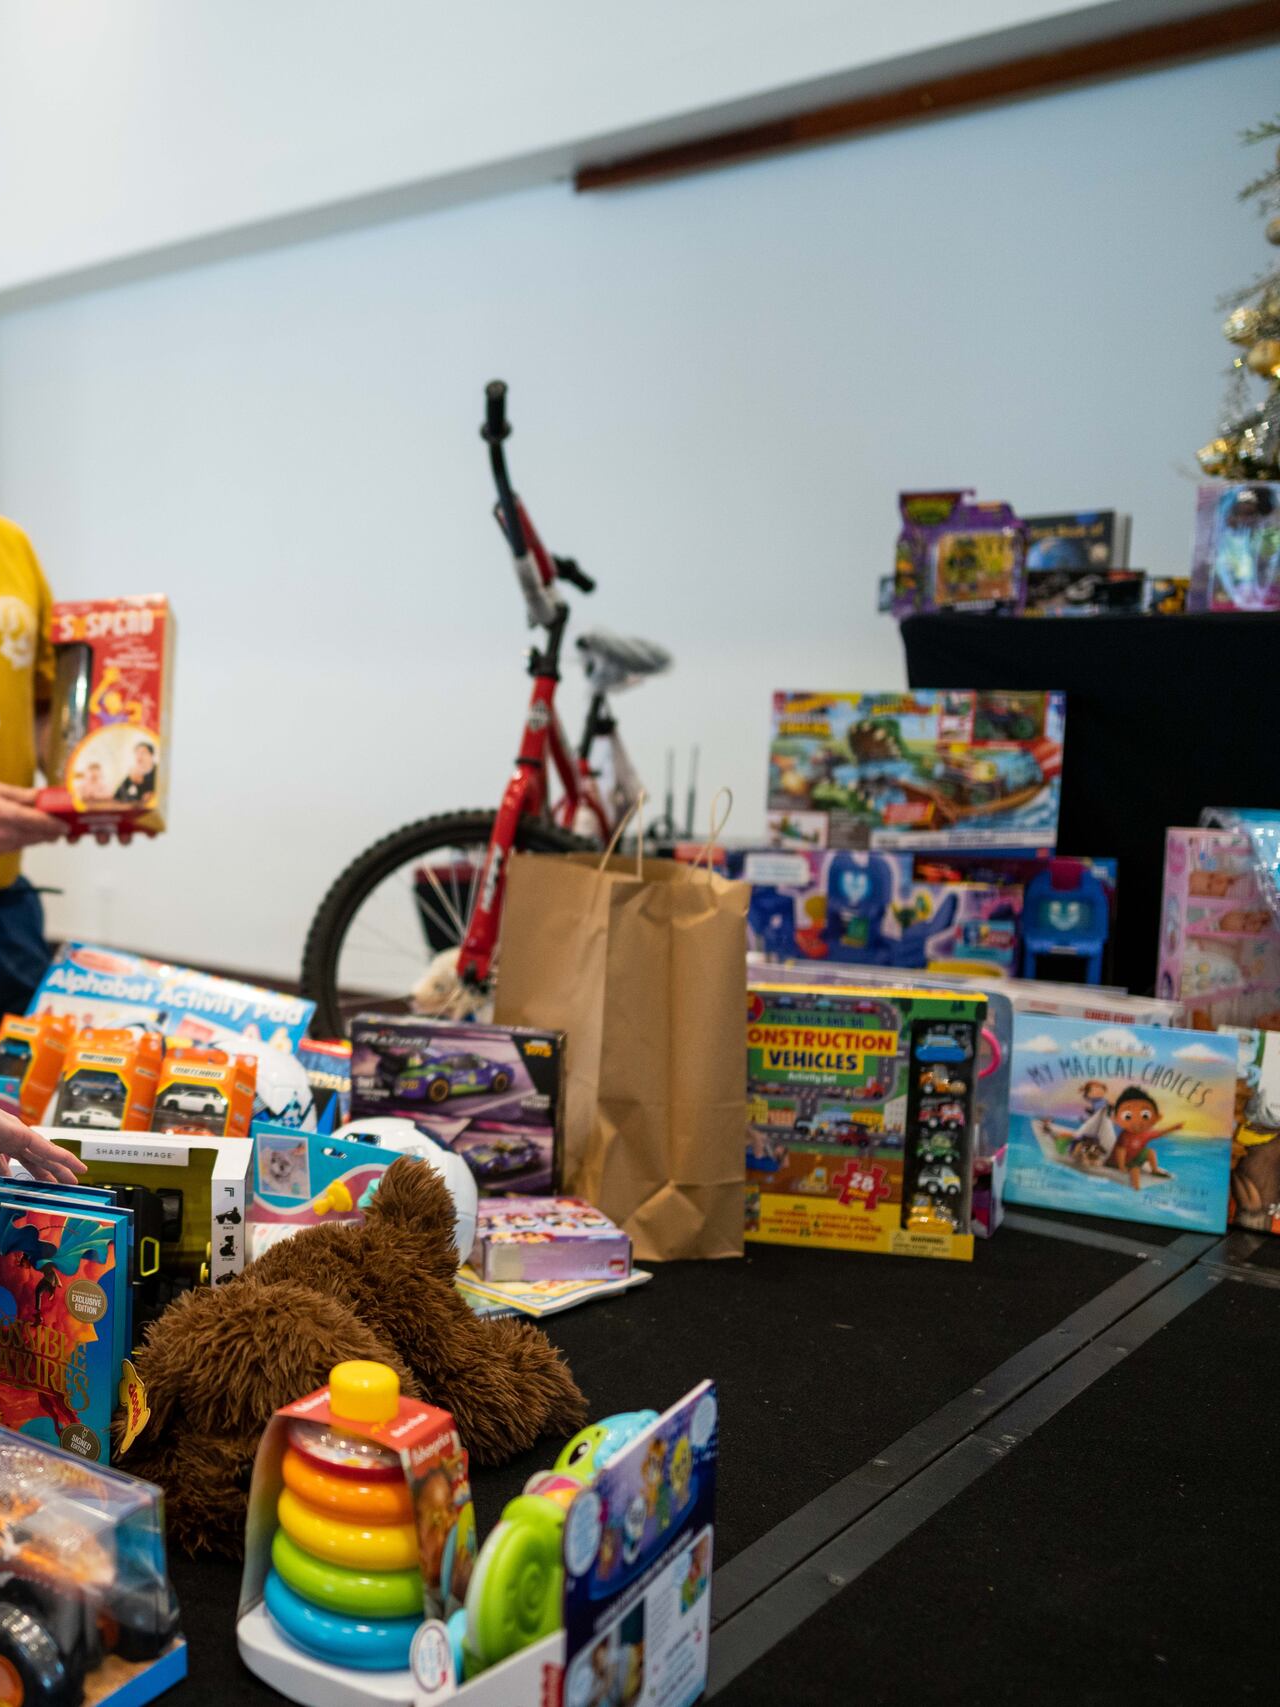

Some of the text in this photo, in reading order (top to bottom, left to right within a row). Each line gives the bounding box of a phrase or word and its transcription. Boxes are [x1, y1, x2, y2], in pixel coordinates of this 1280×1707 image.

[46, 968, 306, 1025] Alphabet Activity Pad
[748, 1028, 892, 1050] ONSTRUCTION
[769, 1051, 858, 1071] VEHICLES
[1027, 1055, 1213, 1108] MY MAGICAL CHOICES
[96, 1148, 173, 1159] SHARPER IMAGE
[72, 1294, 102, 1307] EXCLUSIVE
[75, 1303, 97, 1315] EDITION
[70, 1442, 88, 1455] EDITION
[71, 1434, 92, 1451] SIGNED
